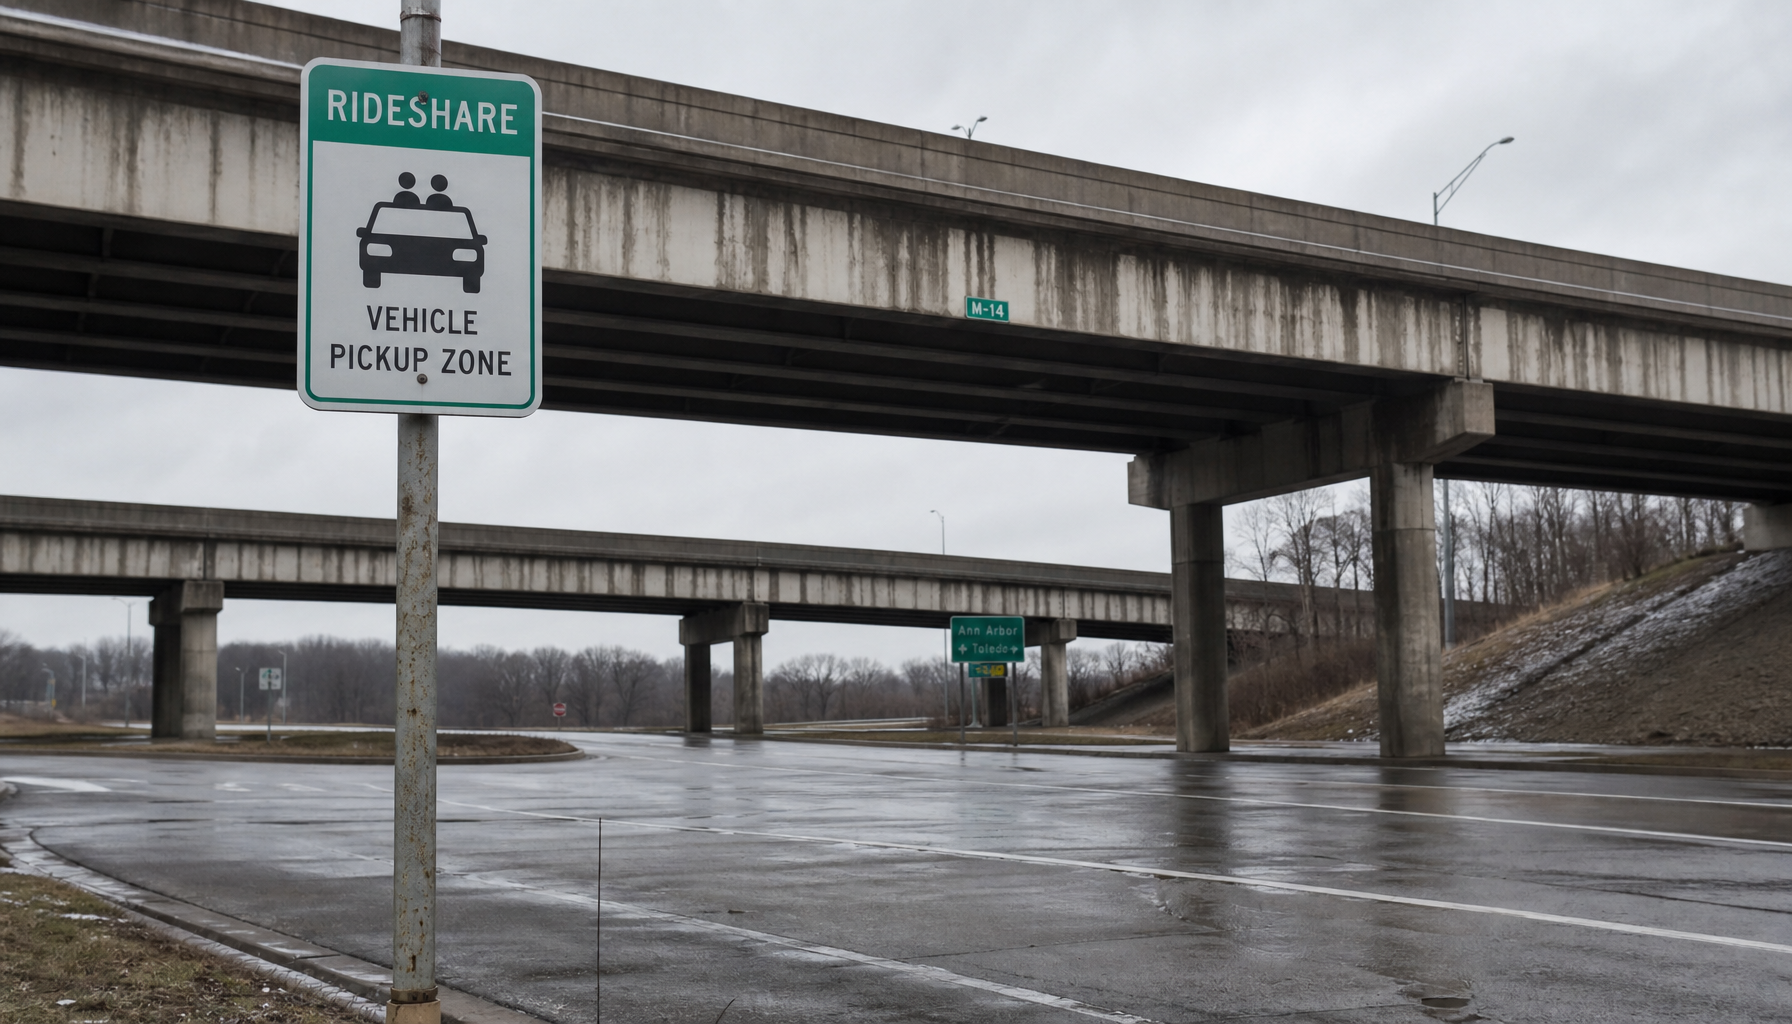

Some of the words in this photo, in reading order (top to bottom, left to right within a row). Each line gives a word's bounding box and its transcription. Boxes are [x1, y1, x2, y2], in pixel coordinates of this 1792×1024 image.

[327, 89, 518, 135] RIDESHARE
[367, 305, 478, 335] VEHICLE
[972, 301, 1004, 318] M-14
[330, 344, 428, 372] PICKUP
[441, 349, 512, 376] ZONE
[958, 625, 980, 635] Ann
[986, 625, 1018, 636] Arbor
